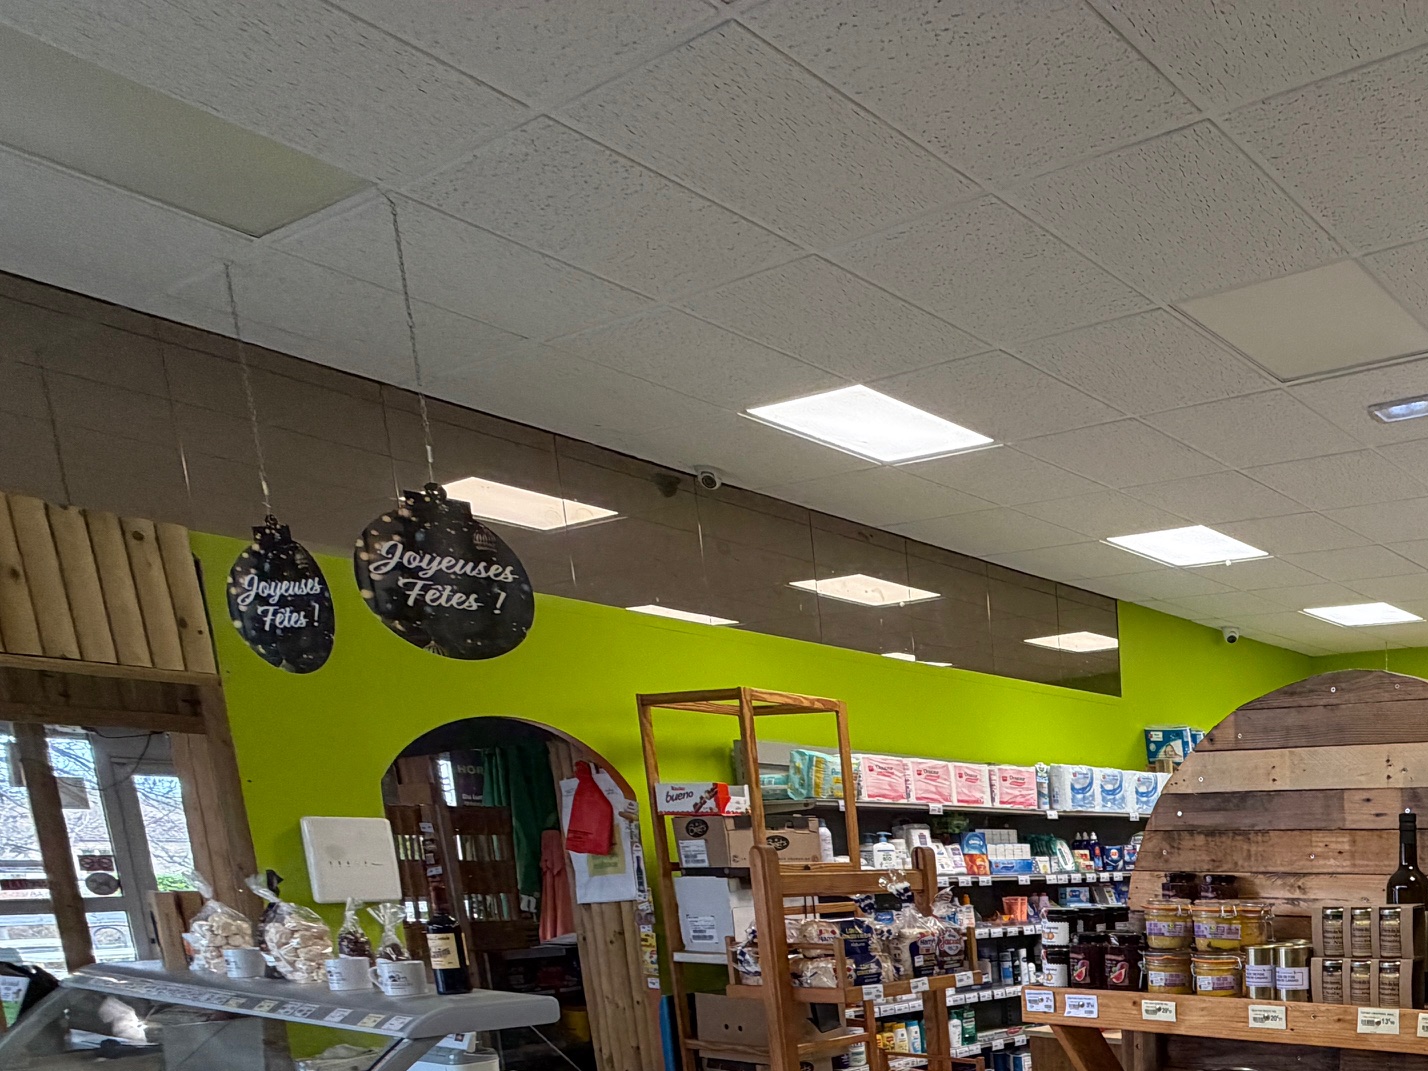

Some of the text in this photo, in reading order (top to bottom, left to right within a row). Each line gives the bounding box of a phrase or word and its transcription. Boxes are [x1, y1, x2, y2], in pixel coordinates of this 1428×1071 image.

[368, 541, 520, 583] Joyeuses
[237, 573, 324, 606] Joyeuses
[397, 577, 507, 615] Fêtes !
[257, 604, 320, 631] Fêtes !
[665, 790, 694, 803] bueno
